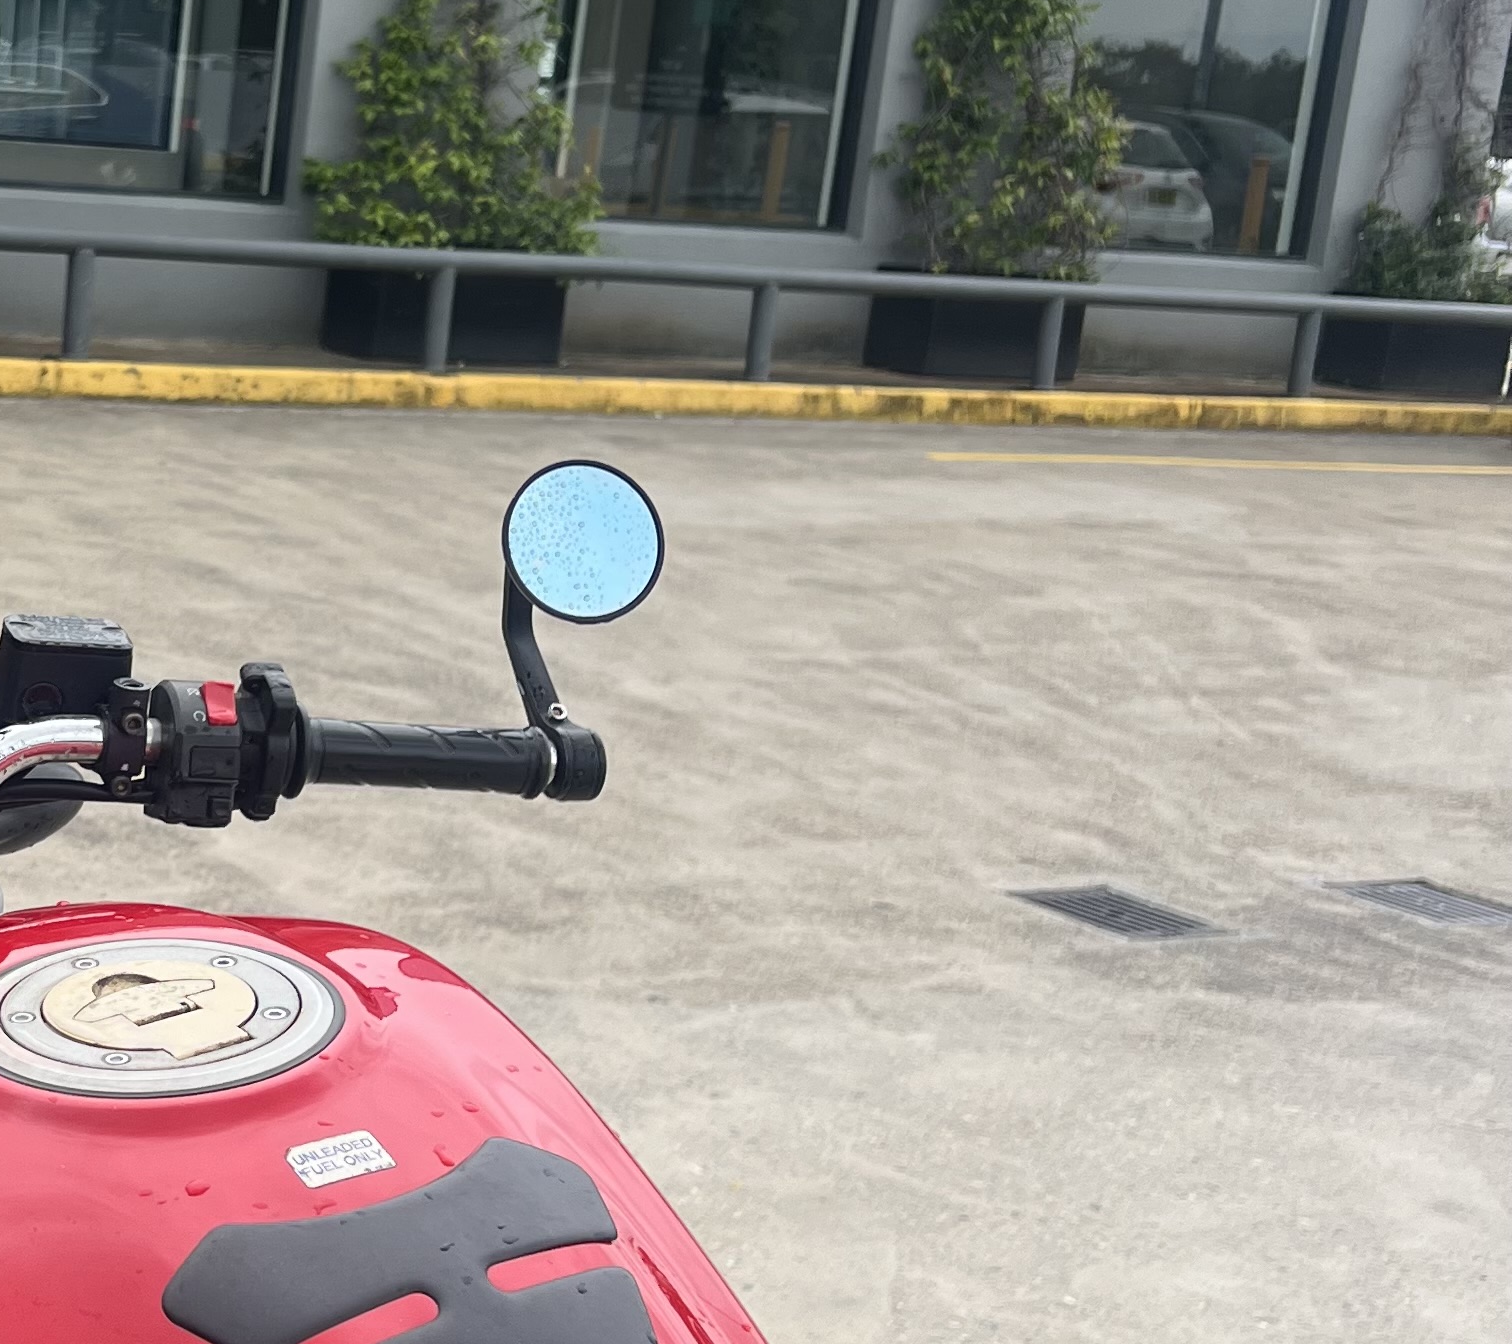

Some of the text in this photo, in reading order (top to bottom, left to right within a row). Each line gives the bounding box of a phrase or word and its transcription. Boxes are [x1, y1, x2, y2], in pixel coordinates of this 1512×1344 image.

[292, 1138, 373, 1165] UNLEADED
[298, 1159, 345, 1181] FUEL
[344, 1149, 384, 1166] ONLY
